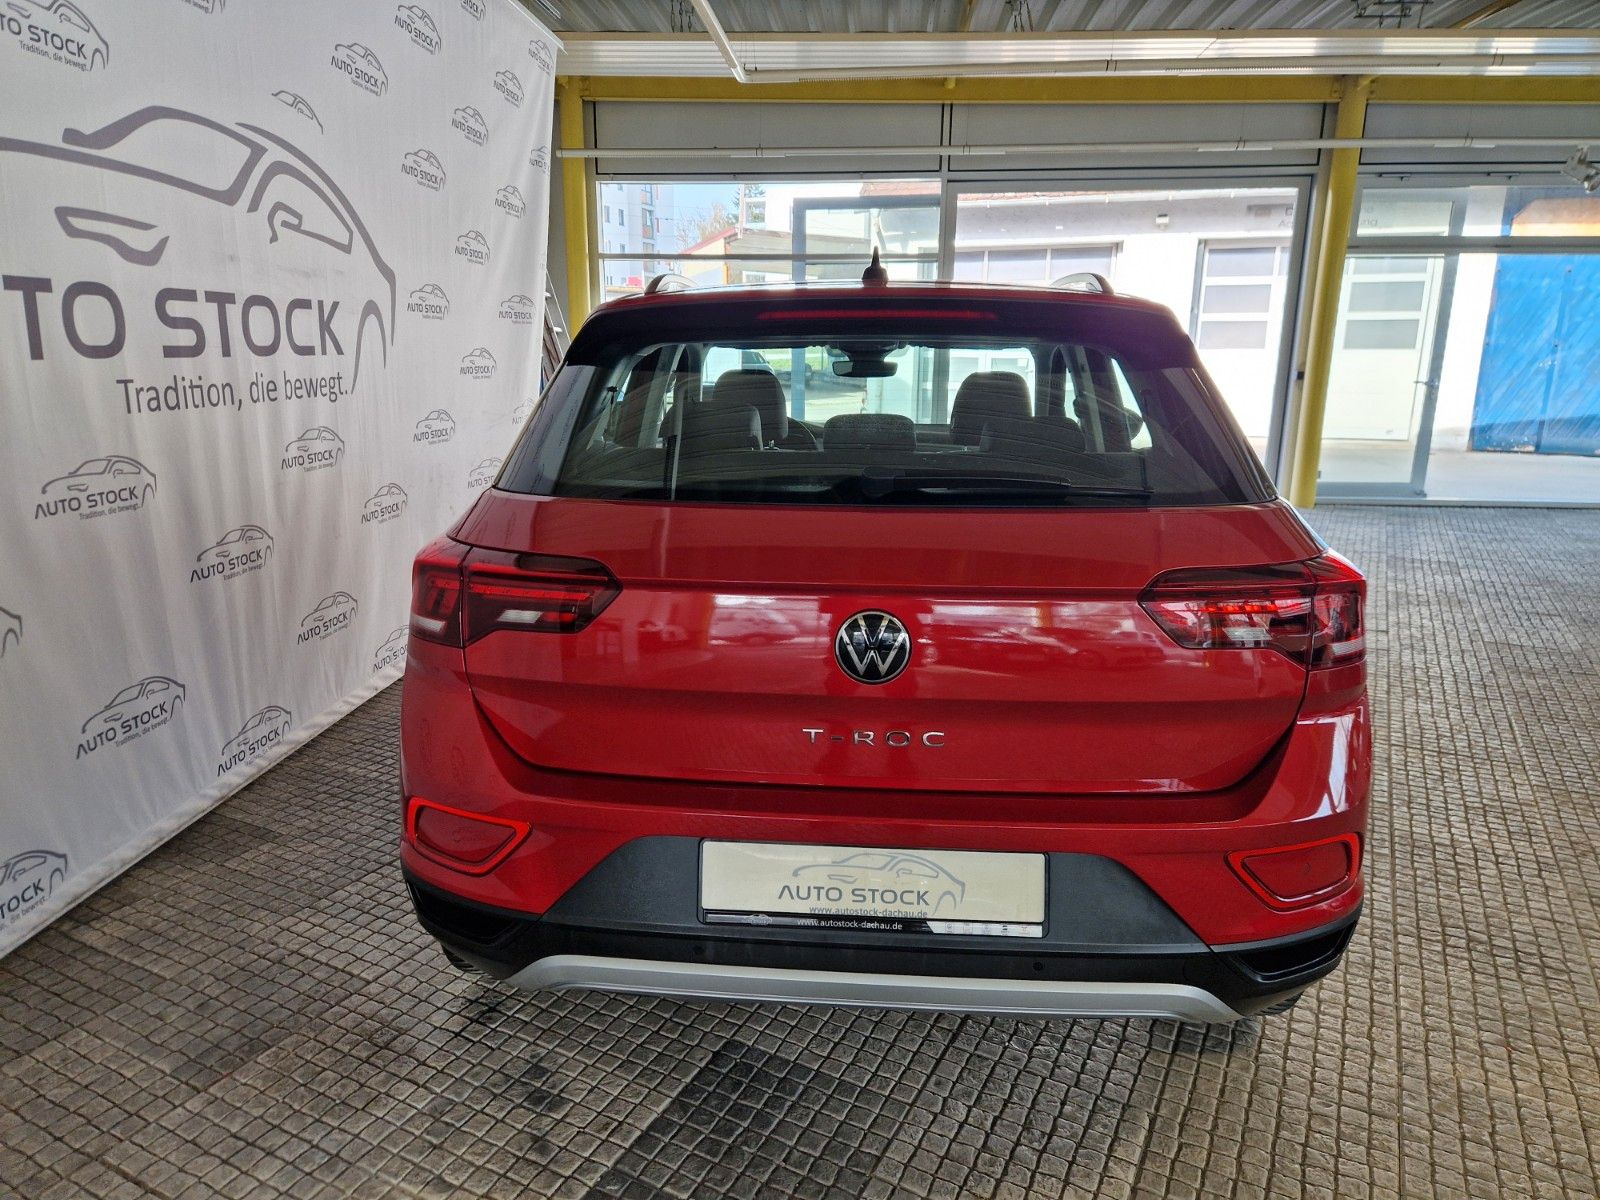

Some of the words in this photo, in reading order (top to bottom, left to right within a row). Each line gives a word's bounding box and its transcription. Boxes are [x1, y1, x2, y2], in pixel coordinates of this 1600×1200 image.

[28, 24, 87, 60] STOCK
[394, 15, 413, 34] AUTO
[414, 28, 434, 47] STOCK
[331, 55, 352, 75] AUTO
[354, 67, 379, 89] STOCK
[401, 163, 418, 178] AUTO
[419, 170, 438, 185] STOCK
[407, 302, 423, 313] AUTO
[424, 304, 443, 314] STOCK
[154, 287, 344, 358] STOCK
[116, 374, 243, 414] Tradition,
[249, 372, 278, 404] die
[284, 370, 348, 403] bewegt.
[413, 431, 430, 442] AUTO
[430, 427, 449, 439] STOCK
[281, 455, 305, 470] AUTO
[307, 449, 334, 464] STOCK
[35, 497, 81, 519] AUTO
[86, 486, 138, 508] STOCK
[361, 509, 379, 524] AUTO
[380, 501, 400, 517] STOCK
[190, 562, 225, 583] AUTO
[228, 549, 263, 571] STOCK
[297, 625, 321, 645] AUTO
[323, 611, 348, 633] STOCK
[373, 655, 391, 673] AUTO
[76, 727, 117, 760] AUTO
[120, 701, 168, 734] STOCK
[802, 727, 945, 747] T-ROC
[217, 749, 246, 777] AUTO
[248, 726, 280, 756] STOCK
[778, 885, 842, 902] AUTO
[850, 887, 931, 907] STOCK
[797, 918, 903, 931] www.autostock-dachau.de
[809, 905, 928, 920] www.autostock-dachau.de
